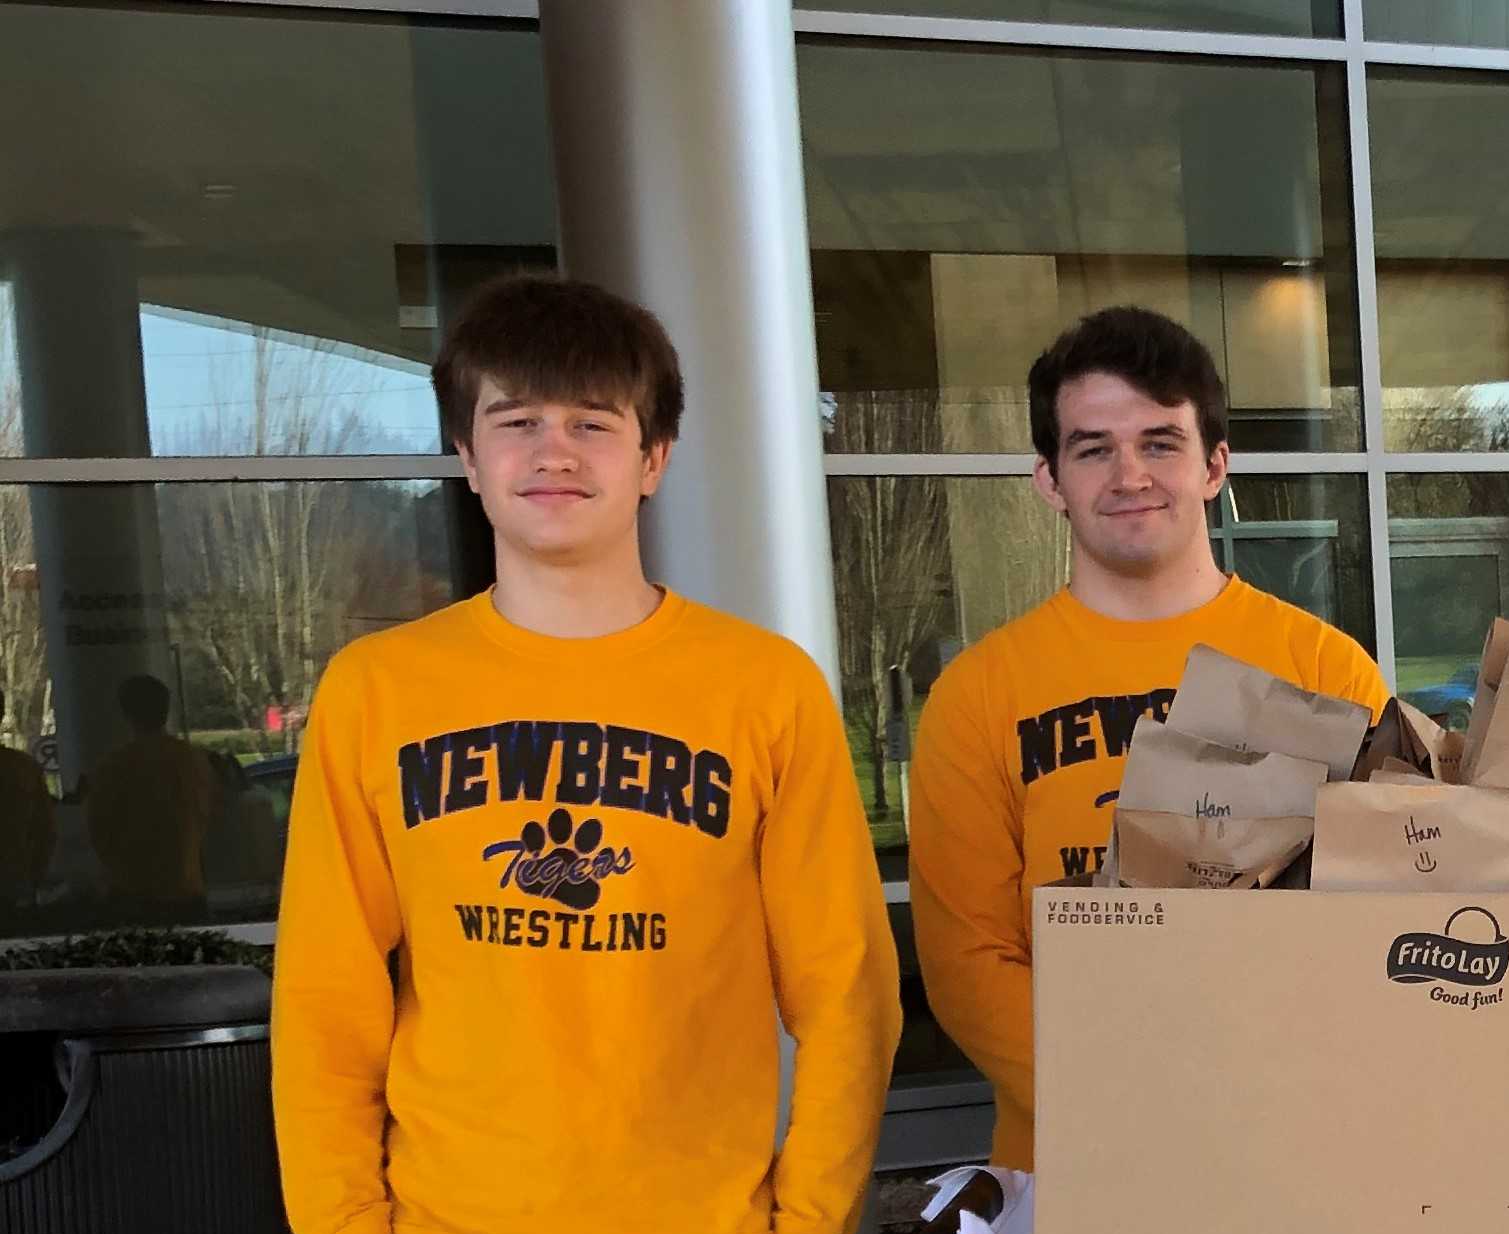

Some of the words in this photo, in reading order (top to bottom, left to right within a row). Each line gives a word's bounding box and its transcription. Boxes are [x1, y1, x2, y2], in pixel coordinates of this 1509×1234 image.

[398, 720, 733, 840] NEWBERG
[1195, 792, 1231, 819] Ham
[1404, 816, 1441, 843] Ham
[482, 839, 636, 898] Tigers
[1047, 901, 1138, 913] VENDING
[1047, 913, 1165, 925] FOODSERVICE
[455, 904, 667, 952] WRESTLING
[1429, 986, 1470, 1006] Good
[1471, 988, 1504, 1011] fun!
